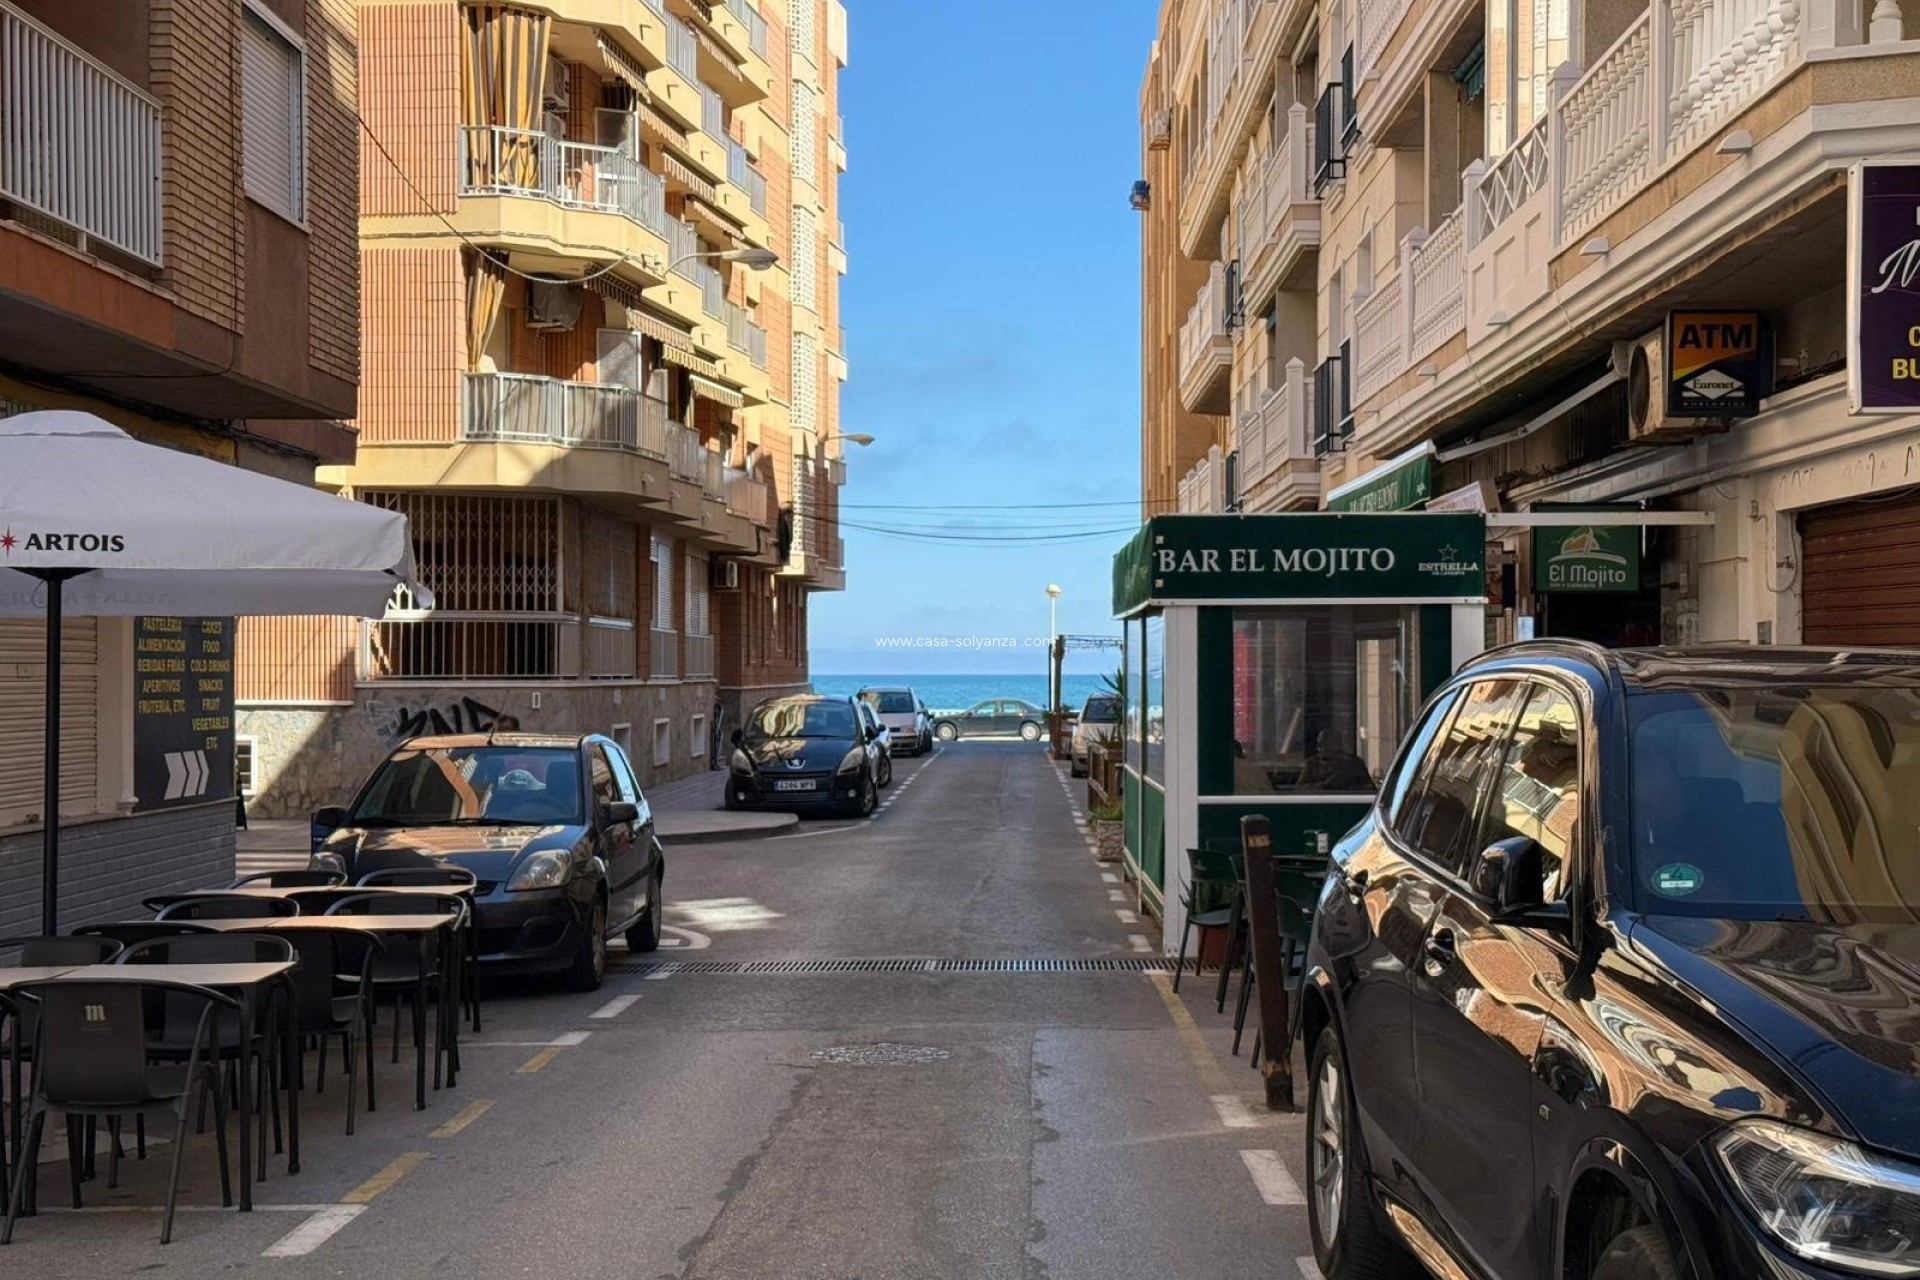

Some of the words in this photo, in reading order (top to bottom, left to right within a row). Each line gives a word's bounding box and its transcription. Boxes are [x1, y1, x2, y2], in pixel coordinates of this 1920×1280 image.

[1679, 324, 1753, 349] ATM
[1693, 379, 1735, 390] Euronet
[24, 533, 125, 552] ARTOIS
[1159, 549, 1221, 573] BAR
[1230, 549, 1265, 572] EL
[1273, 547, 1396, 577] MOJITO
[1419, 562, 1479, 571] ESTRELLA
[1549, 565, 1565, 582] El
[1570, 565, 1627, 588] Mojito
[203, 640, 220, 653] FOOD
[191, 659, 208, 672] COLD
[199, 680, 223, 692] SNACKS
[174, 700, 185, 713] ETC
[203, 699, 220, 711] FRUIT
[206, 736, 218, 749] ETC
